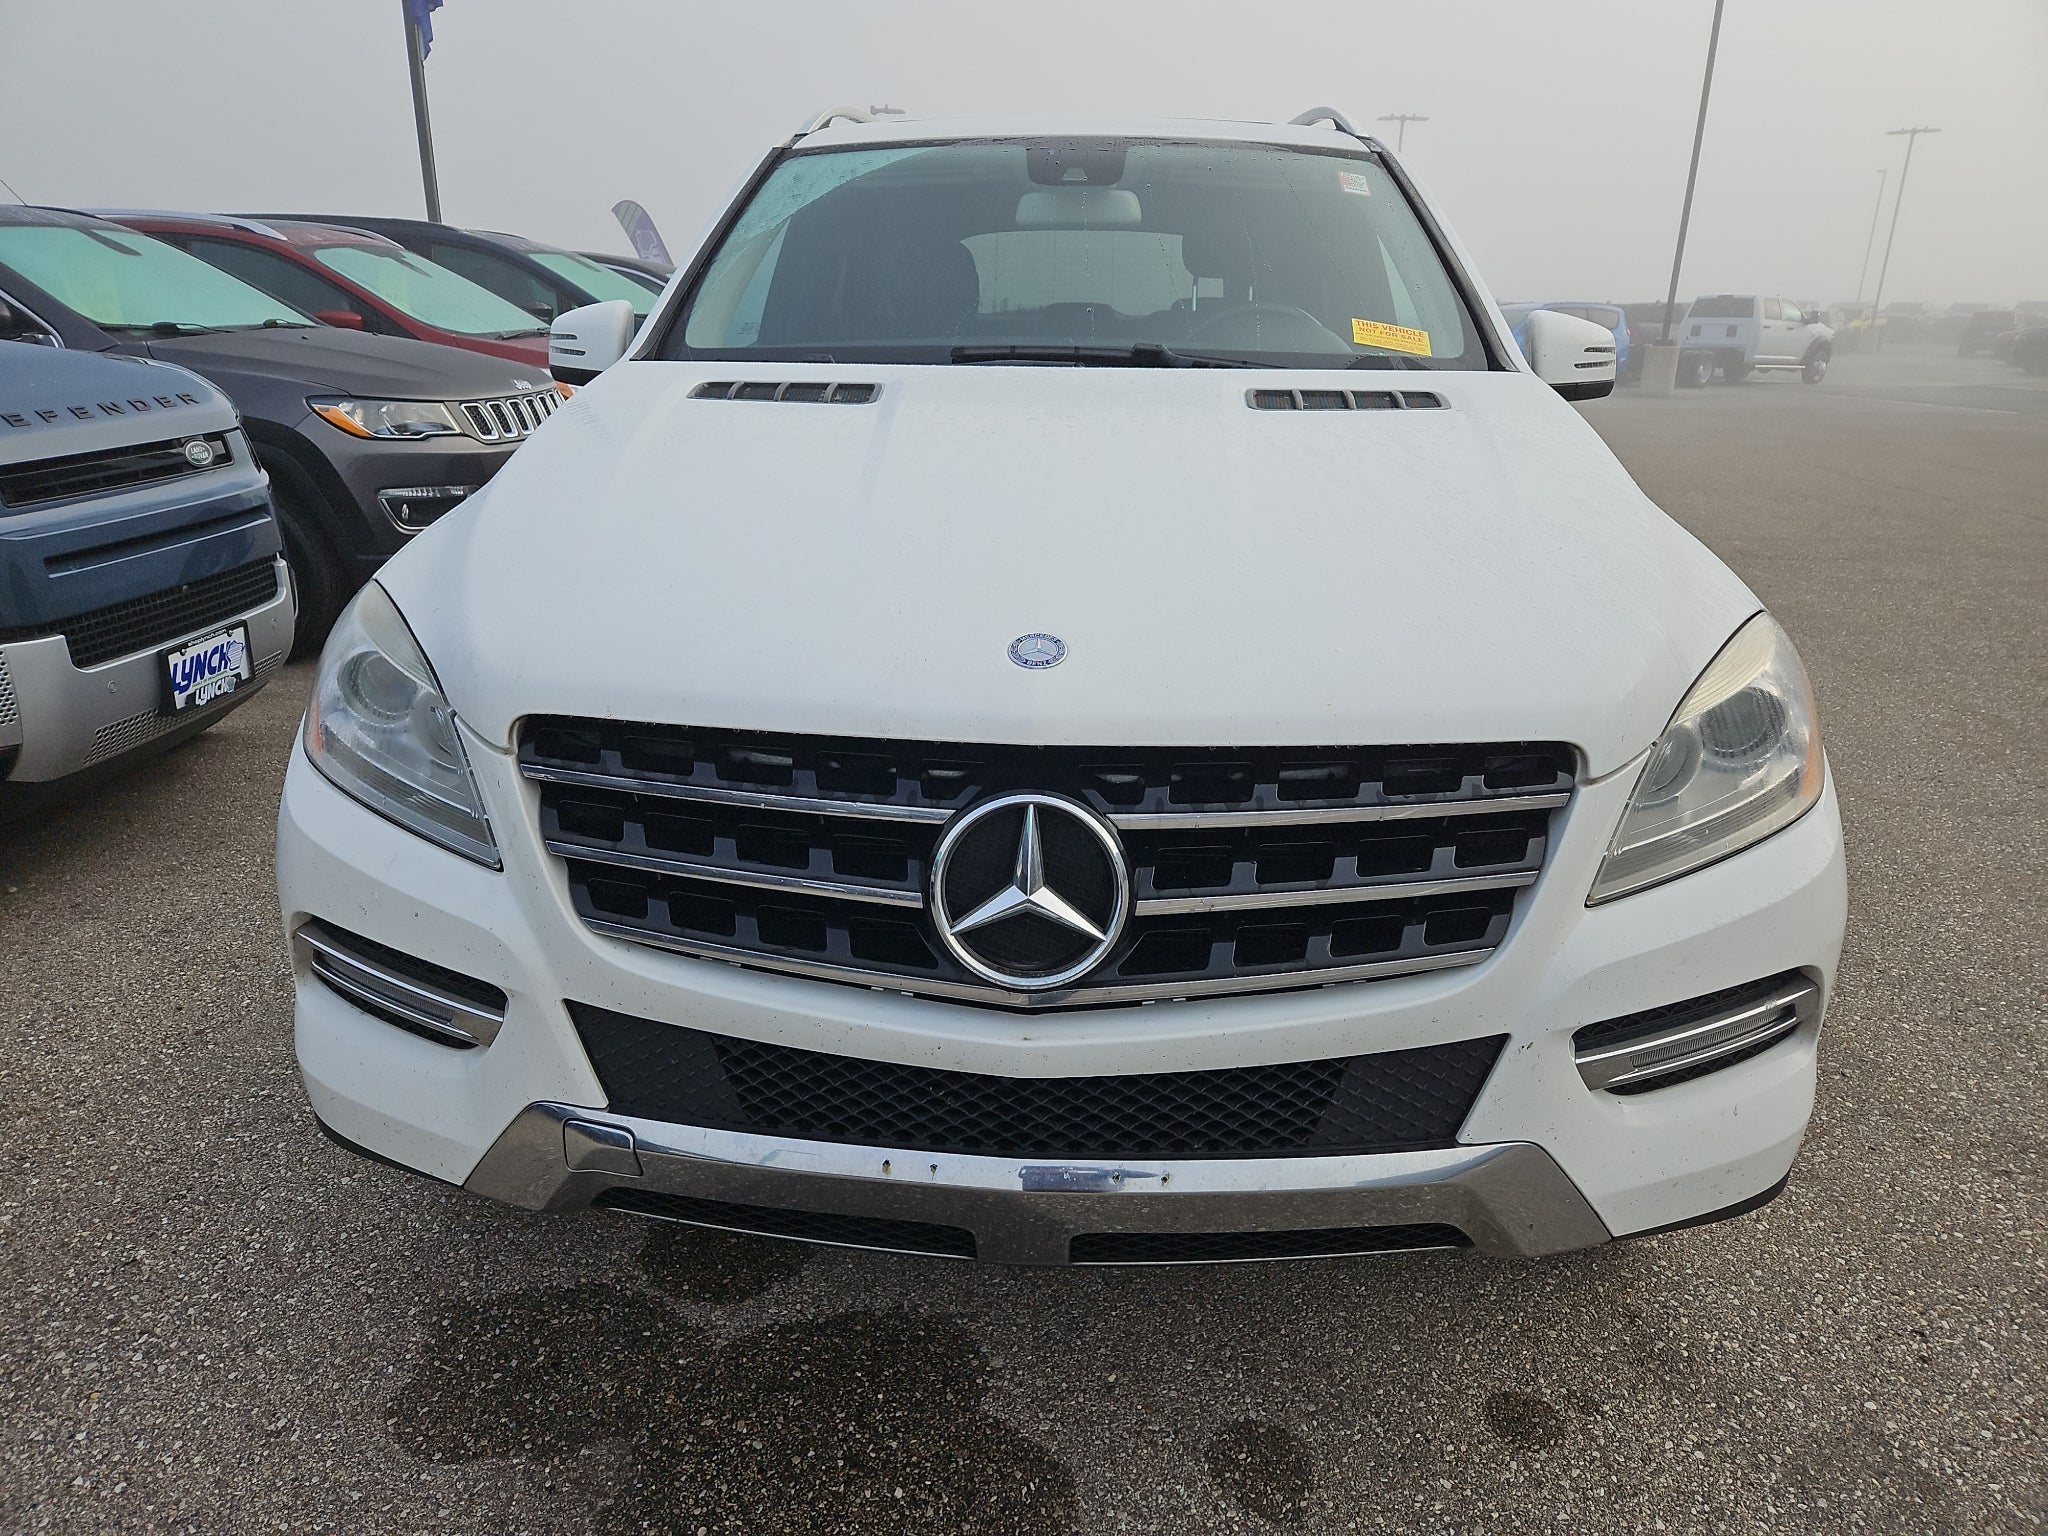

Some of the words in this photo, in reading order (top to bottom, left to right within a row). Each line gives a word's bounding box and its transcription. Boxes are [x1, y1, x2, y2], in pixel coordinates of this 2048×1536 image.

[1356, 320, 1378, 329] THIS
[1381, 324, 1425, 338] VEHICLE
[1401, 334, 1424, 342] SALE
[171, 640, 231, 695] LYNCH
[195, 677, 228, 706] LYNCH
